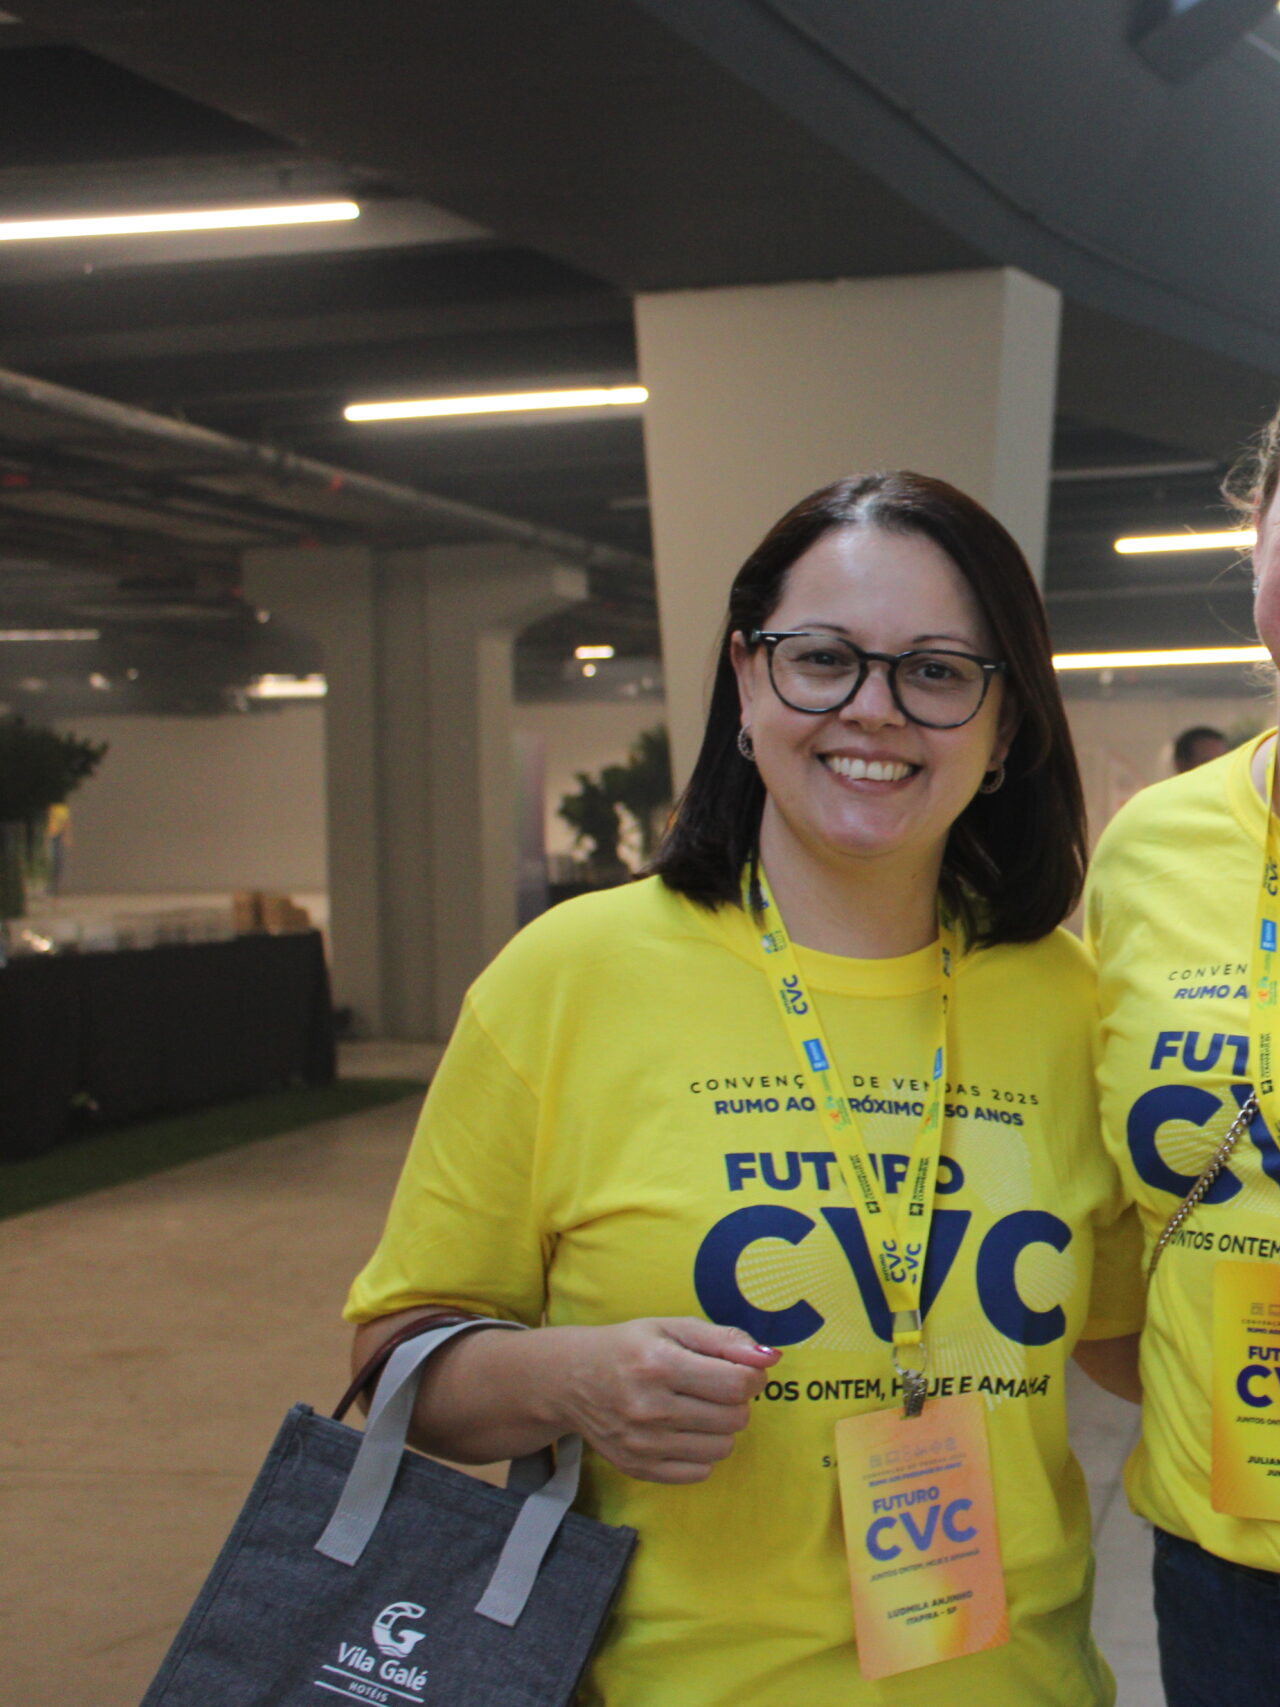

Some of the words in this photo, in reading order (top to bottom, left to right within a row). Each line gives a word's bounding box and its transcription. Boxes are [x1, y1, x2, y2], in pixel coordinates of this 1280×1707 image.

[1168, 963, 1248, 981] CONVEN
[782, 974, 809, 1015] CVC
[1174, 985, 1231, 999] RUMO
[690, 1074, 805, 1094] CONVENÇ
[853, 1075, 880, 1088] DE
[991, 1089, 1039, 1105] 2025
[714, 1097, 779, 1115] RUMO
[786, 1096, 816, 1112] AO
[847, 1094, 925, 1117] RÓXIMO
[944, 1104, 968, 1118] 50
[974, 1107, 1024, 1126] ANOS
[724, 1151, 964, 1194] FUTRO
[694, 1204, 1073, 1346] CVC
[882, 1239, 906, 1283] CVC
[807, 1378, 886, 1400] ONTEM,
[892, 1377, 954, 1397] HJE
[960, 1376, 973, 1394] E
[872, 1486, 940, 1514] FUTURO
[866, 1498, 977, 1561] CVC
[337, 1642, 376, 1672] Vila
[379, 1659, 429, 1691] Galé
